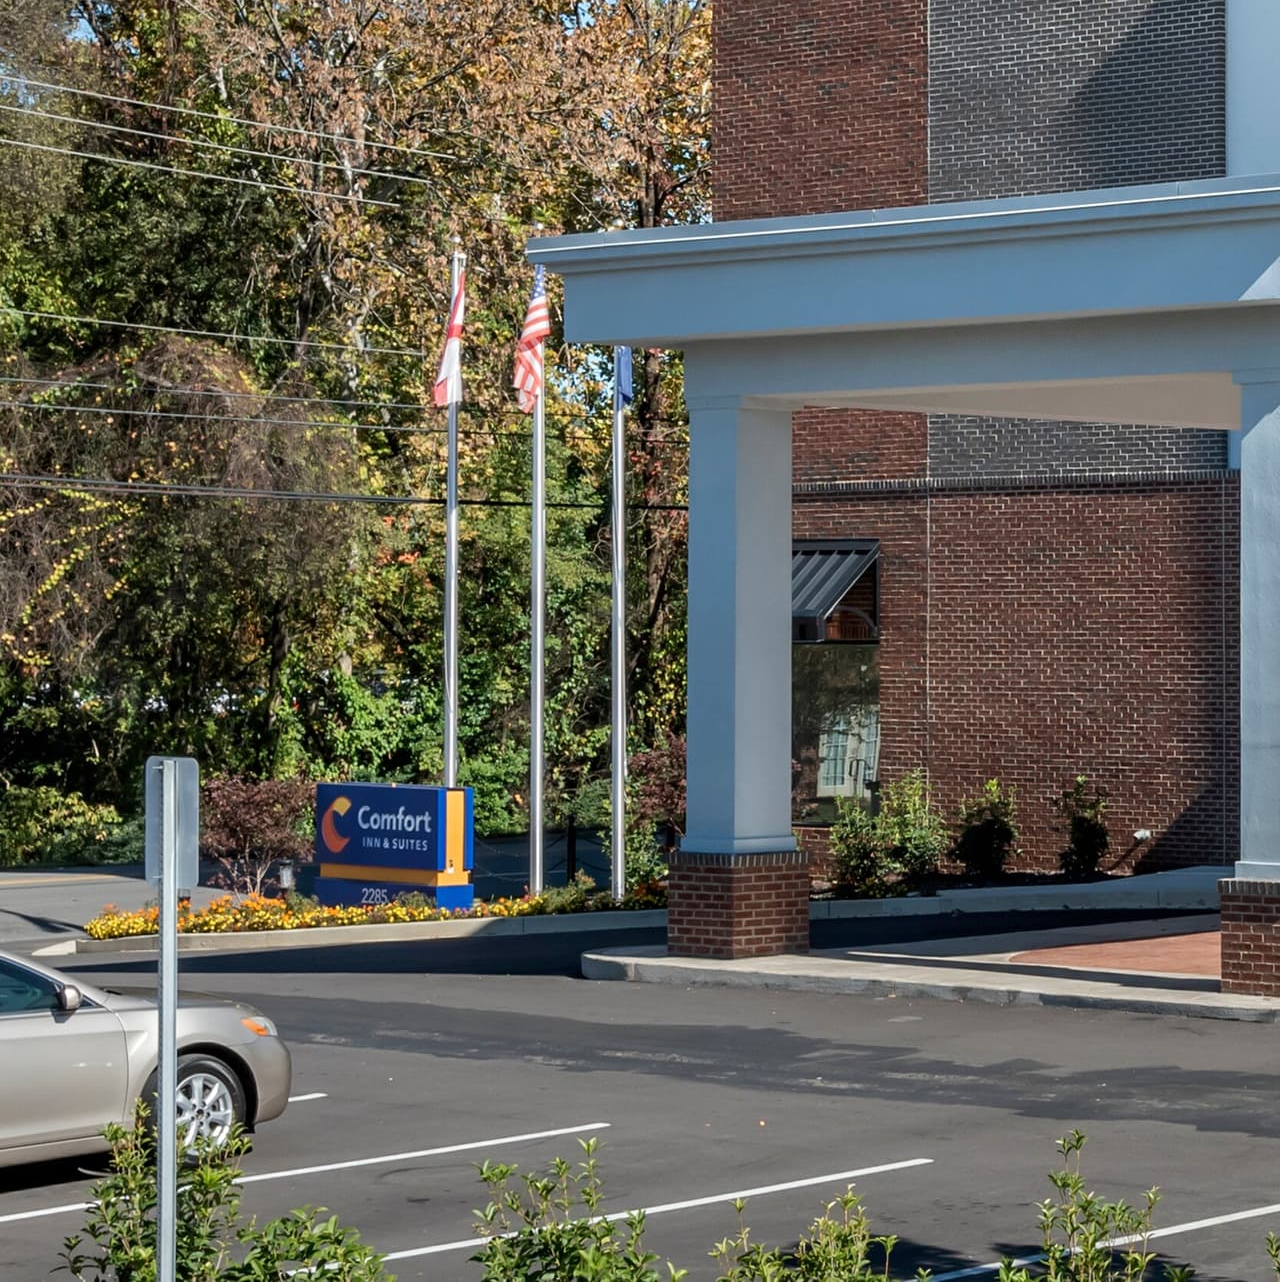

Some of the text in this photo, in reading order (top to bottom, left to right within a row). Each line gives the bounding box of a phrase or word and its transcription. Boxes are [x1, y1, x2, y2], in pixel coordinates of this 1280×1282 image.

[357, 805, 432, 833] Comfort
[362, 836, 428, 851] INN & SUITES
[361, 887, 388, 904] 2285
